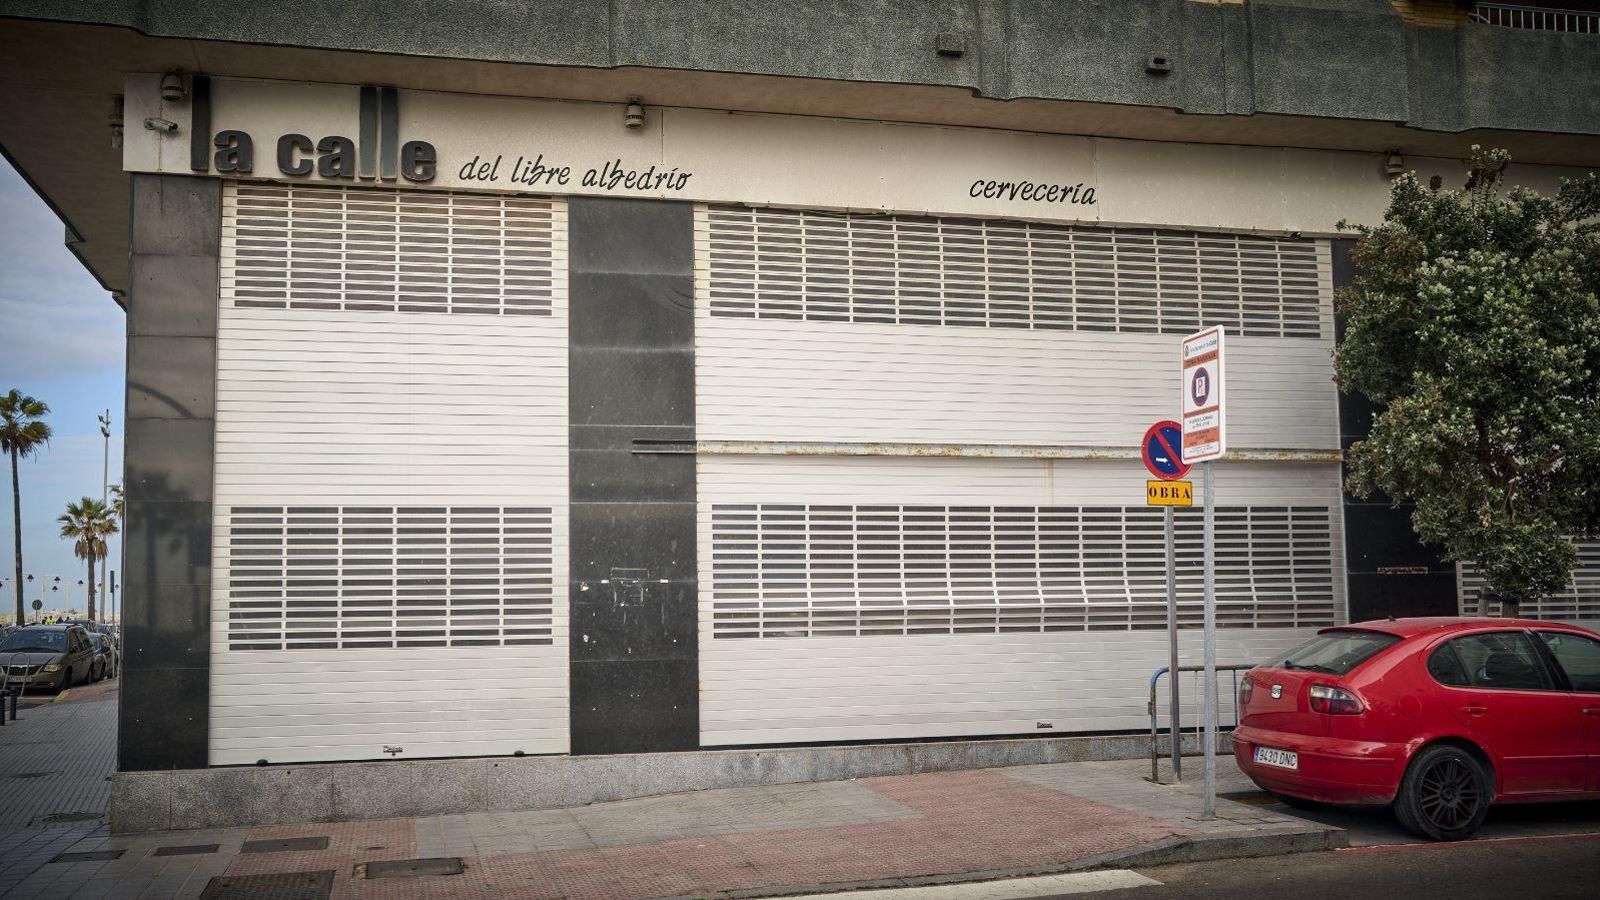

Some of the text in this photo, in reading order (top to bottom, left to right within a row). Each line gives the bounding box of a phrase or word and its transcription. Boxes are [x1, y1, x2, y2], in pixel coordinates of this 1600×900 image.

[191, 75, 437, 182] la calle
[459, 154, 692, 190] del libre albedrío
[969, 179, 1097, 205] cervecería
[1149, 486, 1190, 499] OBRA
[1279, 752, 1296, 767] DNC
